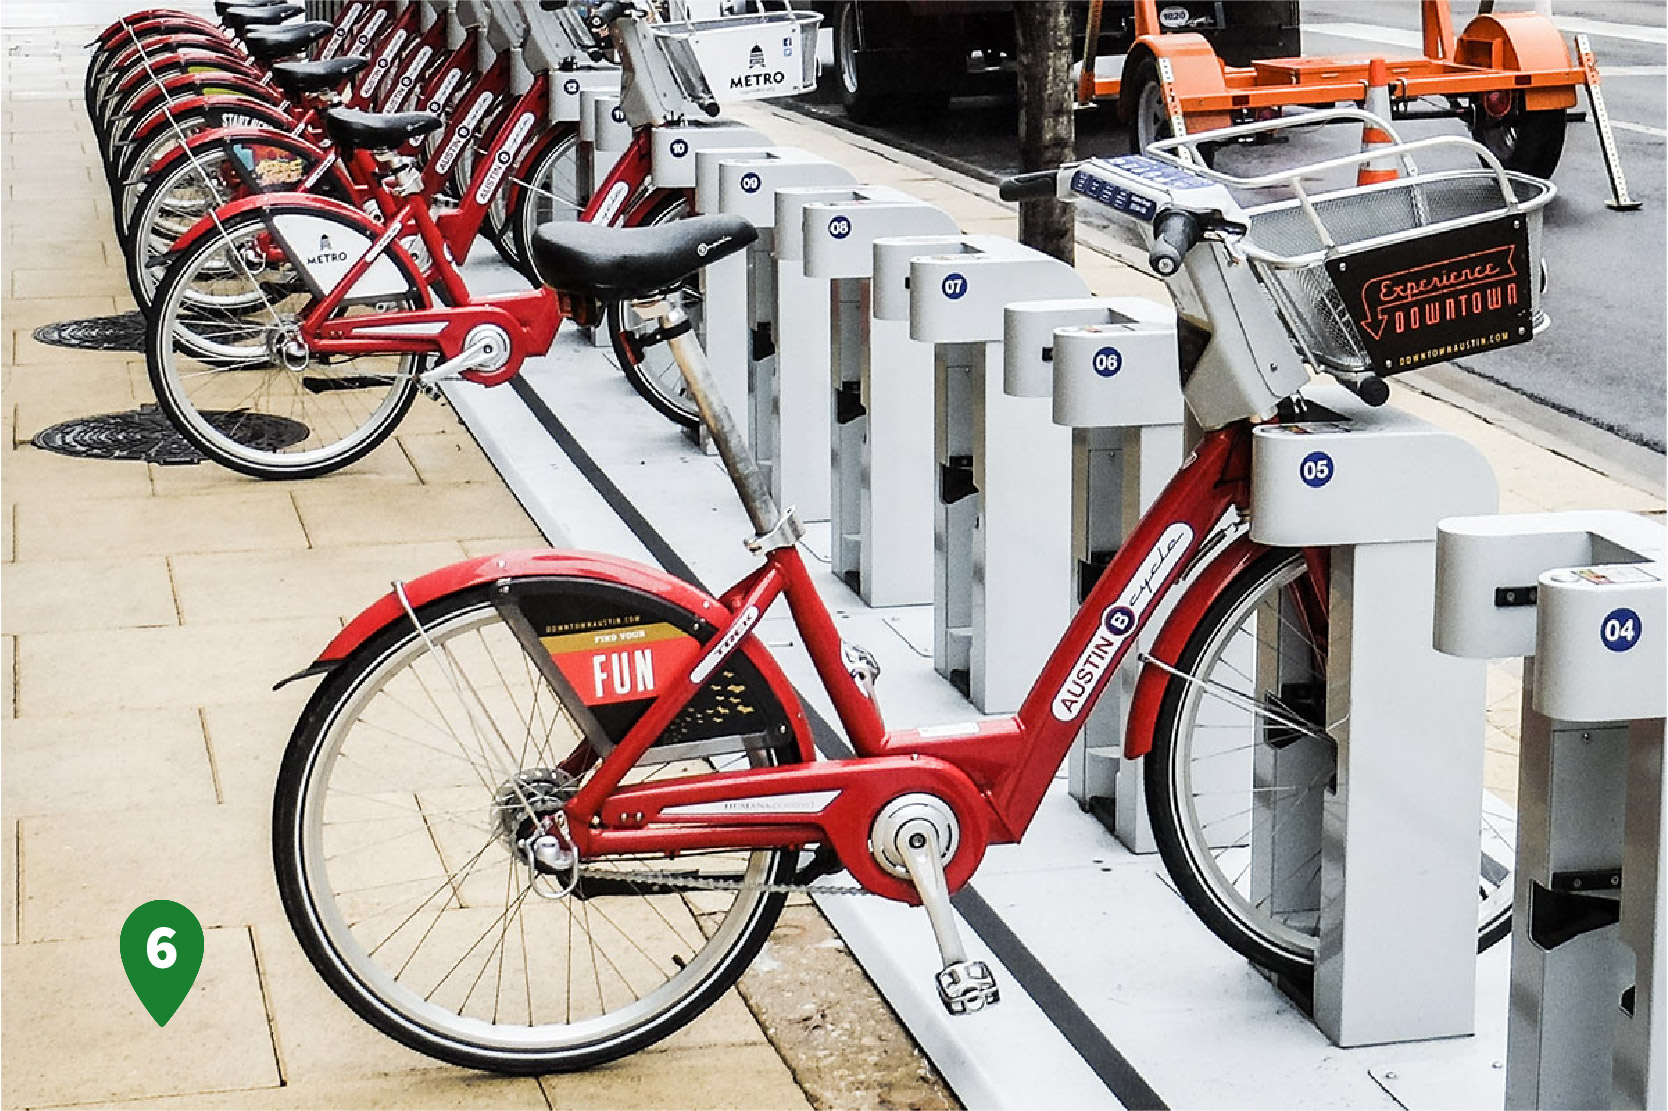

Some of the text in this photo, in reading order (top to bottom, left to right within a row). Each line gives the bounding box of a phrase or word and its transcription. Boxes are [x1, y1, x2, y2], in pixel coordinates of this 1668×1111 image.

[730, 70, 785, 89] METRO
[672, 143, 686, 155] 10
[480, 164, 503, 200] AUSTIN
[743, 176, 758, 189] 09
[829, 220, 849, 235] 08
[307, 251, 348, 265] METRO
[944, 279, 962, 293] 07
[1380, 262, 1500, 302] Experience
[1395, 282, 1518, 334] DOWNTOWN
[1399, 331, 1509, 366] DOWNTOWNAUSTIN.COM
[1096, 353, 1118, 371] 06
[1303, 460, 1329, 480] 05
[594, 629, 646, 644] FIND YOUR
[1605, 618, 1635, 642] 04
[592, 648, 655, 698] FUN
[1060, 635, 1115, 714] AUSTIN
